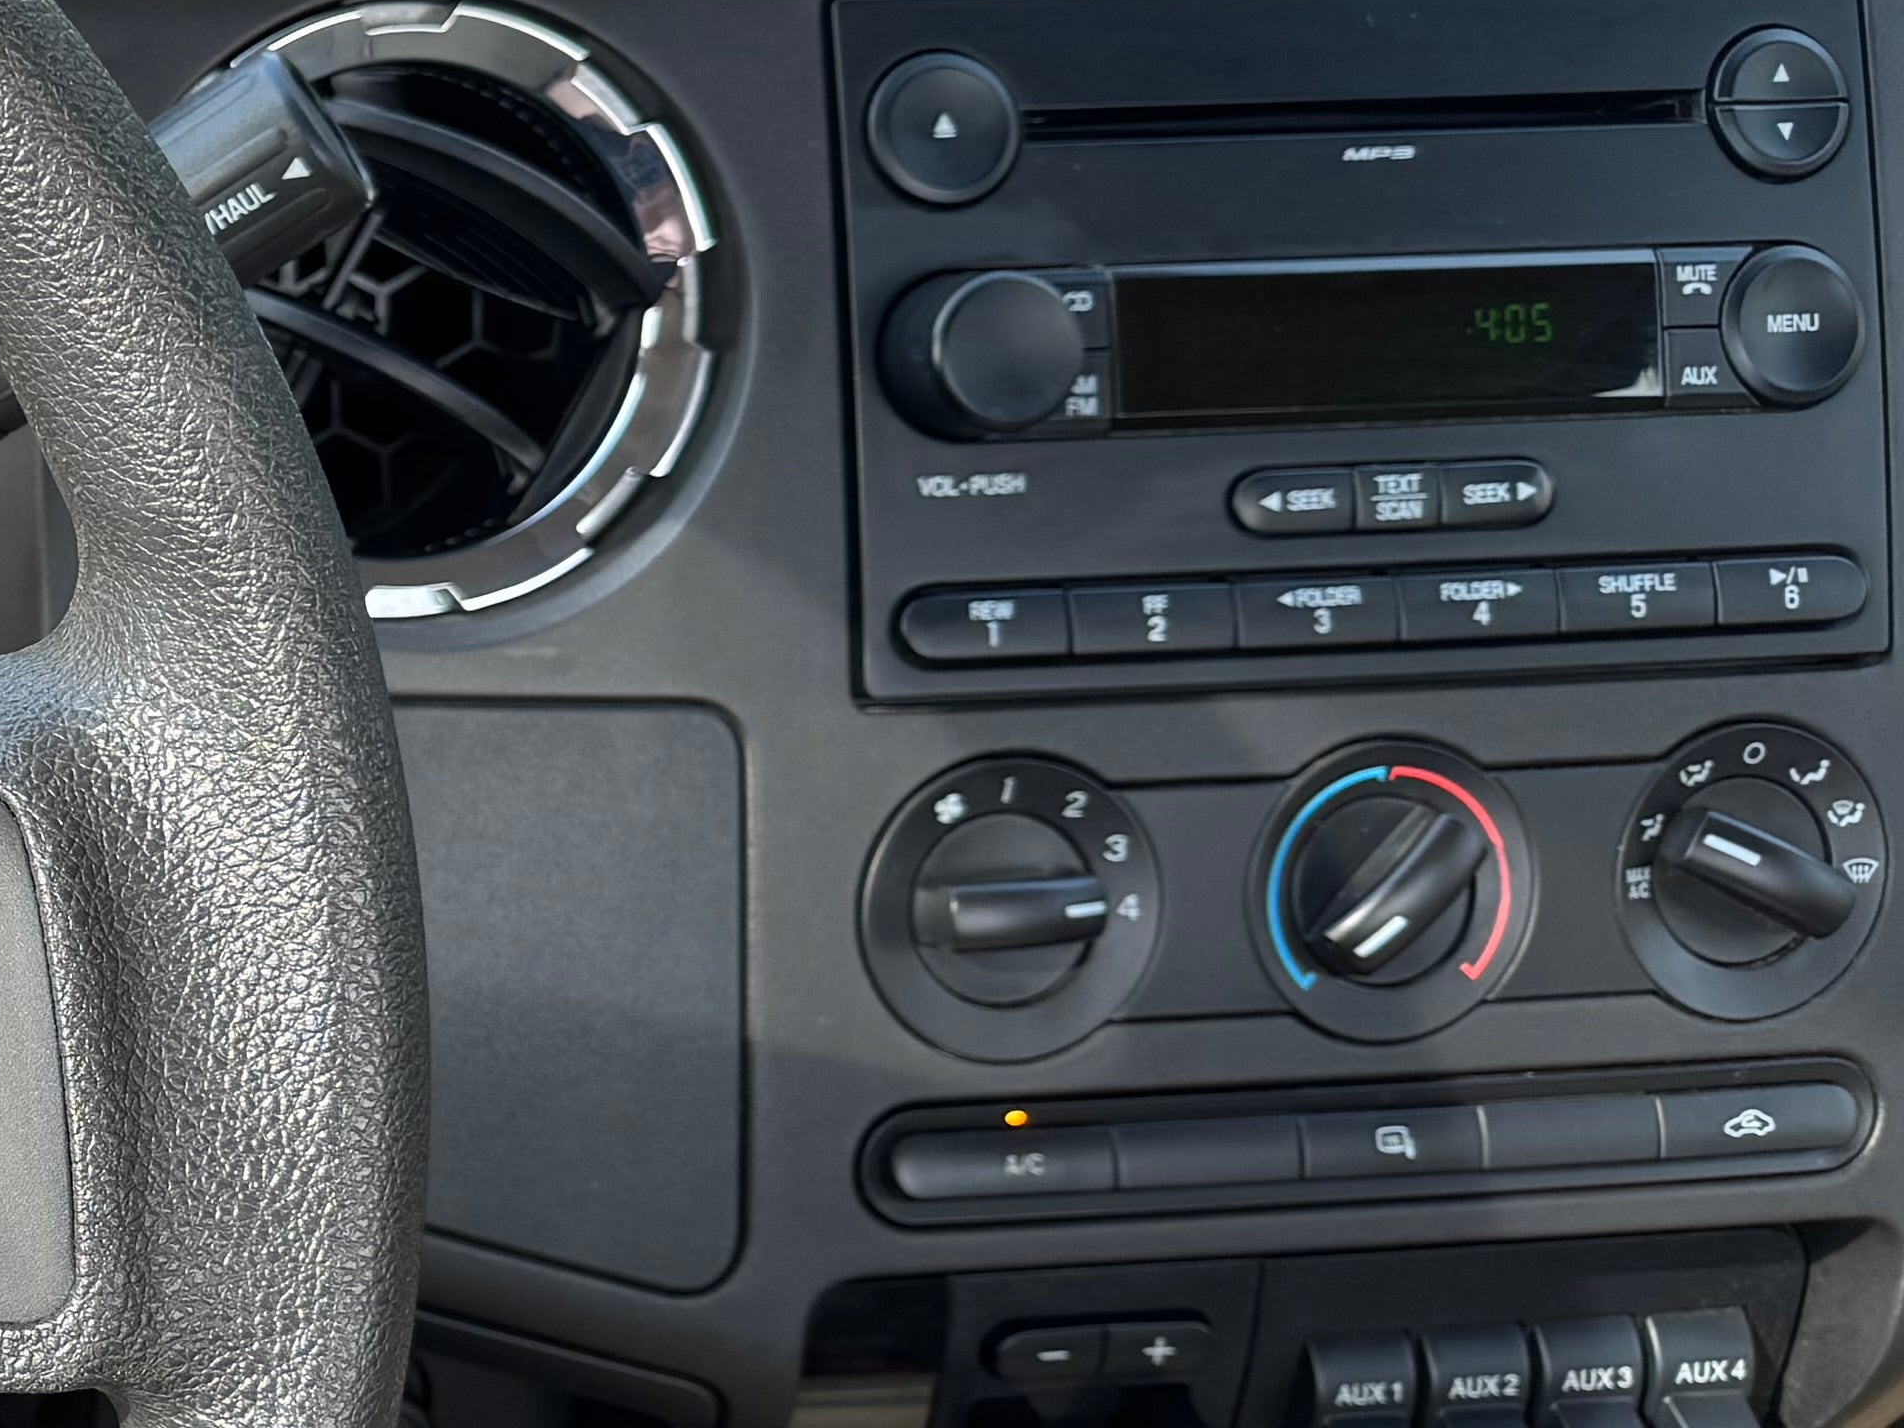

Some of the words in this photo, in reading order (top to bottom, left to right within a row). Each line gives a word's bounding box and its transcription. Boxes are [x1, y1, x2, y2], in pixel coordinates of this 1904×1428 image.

[1342, 145, 1416, 162] MP3
[1677, 264, 1717, 283] MUTE
[1767, 314, 1819, 333] MENU
[1682, 366, 1717, 386] AUX
[1374, 473, 1423, 495] TEXT
[1463, 483, 1511, 505] SEEK
[1287, 488, 1337, 511] SEEK
[1376, 500, 1423, 521] SCAN
[1440, 581, 1506, 602] FOLDER
[1599, 573, 1677, 594] SHUFFLE
[1631, 594, 1647, 619] 5
[1785, 585, 1800, 609] 6
[1313, 609, 1333, 634] 3
[1473, 603, 1491, 626] 4
[987, 622, 1001, 647] 1
[1147, 616, 1168, 642] 2
[1000, 777, 1015, 804] 1
[1062, 791, 1089, 818] 2
[1103, 834, 1129, 862] 3
[1117, 894, 1142, 921] 4
